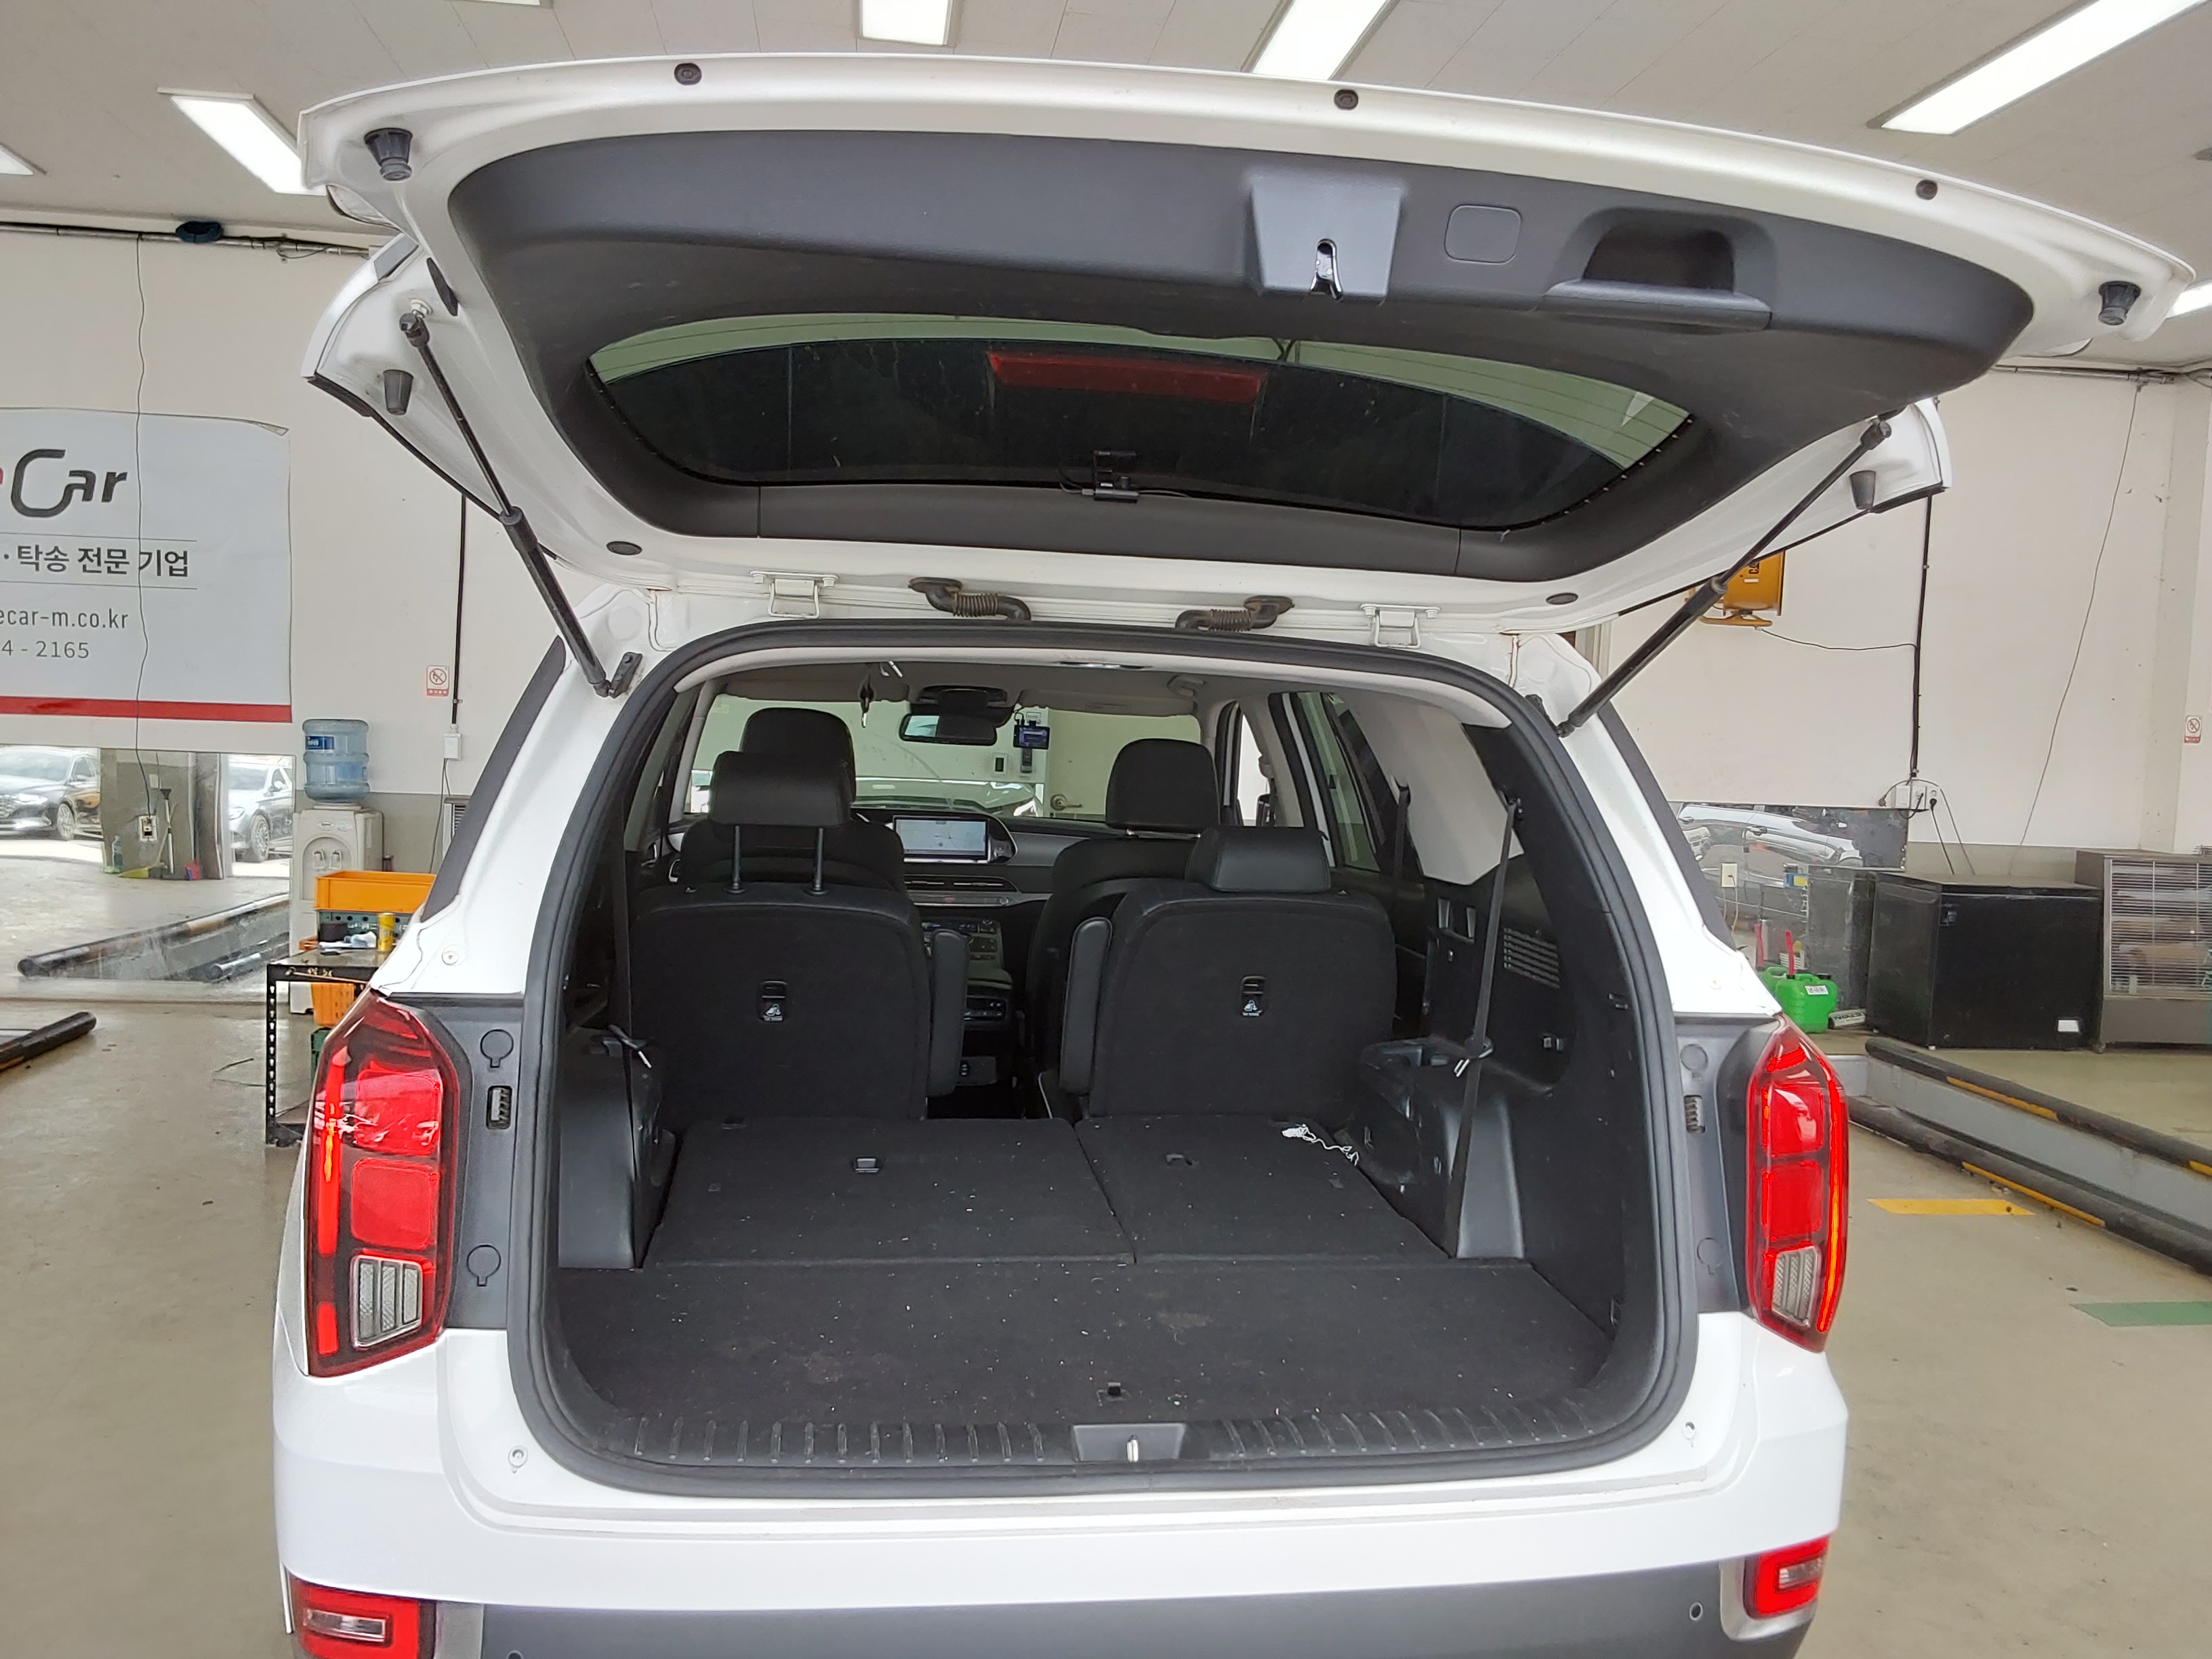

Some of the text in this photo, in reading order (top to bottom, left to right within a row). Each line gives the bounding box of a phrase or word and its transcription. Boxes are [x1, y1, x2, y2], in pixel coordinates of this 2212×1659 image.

[0, 449, 128, 518] Car
[77, 547, 130, 575] 전문
[138, 549, 188, 577] 기업
[35, 640, 89, 659] 2165
